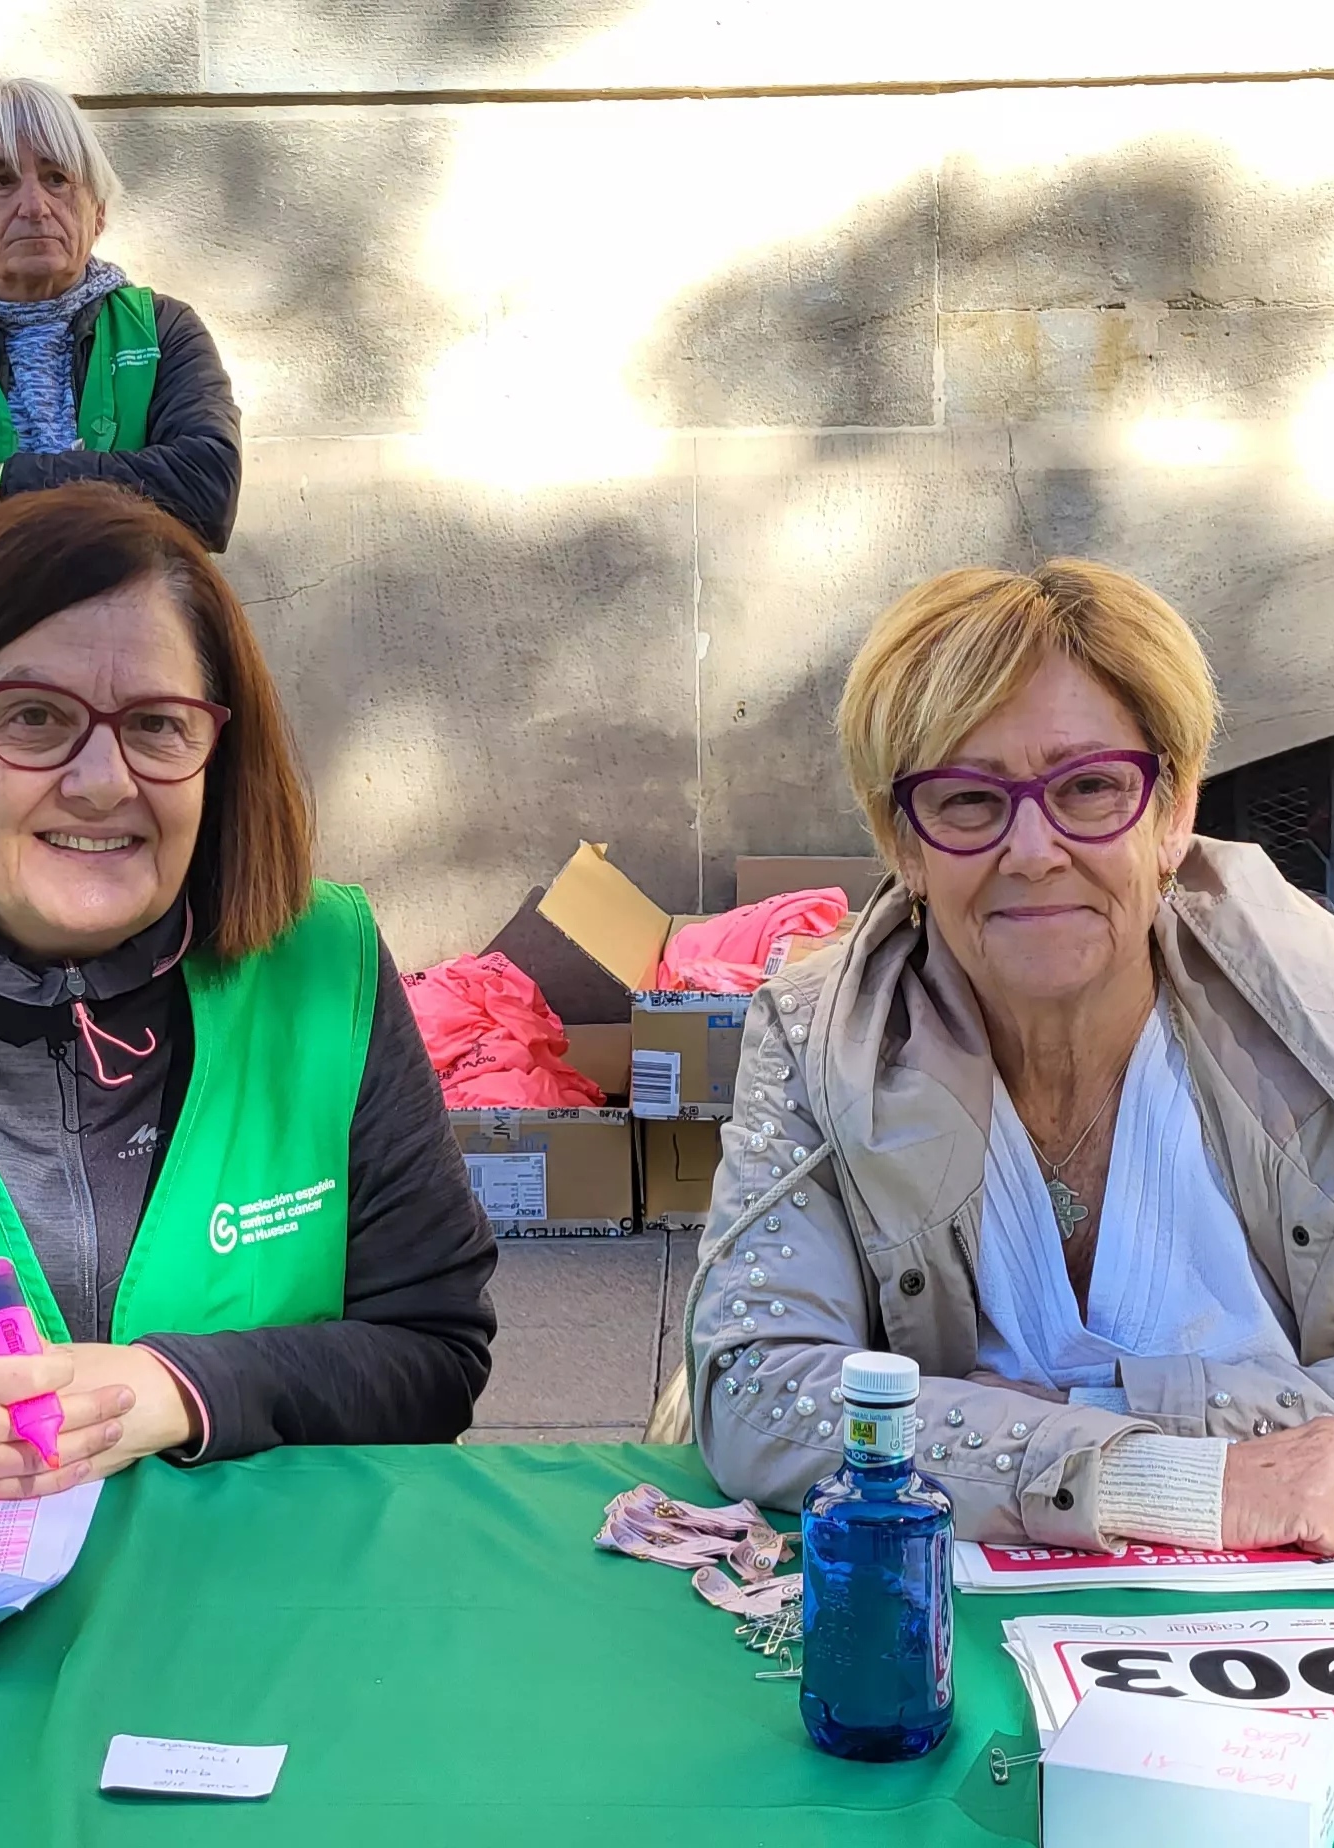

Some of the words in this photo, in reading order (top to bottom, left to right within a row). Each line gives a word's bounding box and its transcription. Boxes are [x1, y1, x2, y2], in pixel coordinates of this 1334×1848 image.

[239, 1190, 293, 1215] asociación
[295, 1178, 335, 1199] española
[240, 1214, 273, 1229] contra
[275, 1210, 286, 1220] el
[288, 1198, 323, 1218] cáncer
[241, 1234, 254, 1244] en
[256, 1221, 298, 1241] Huesca
[1139, 1553, 1248, 1565] HUESCA
[1167, 1623, 1244, 1634] castellar
